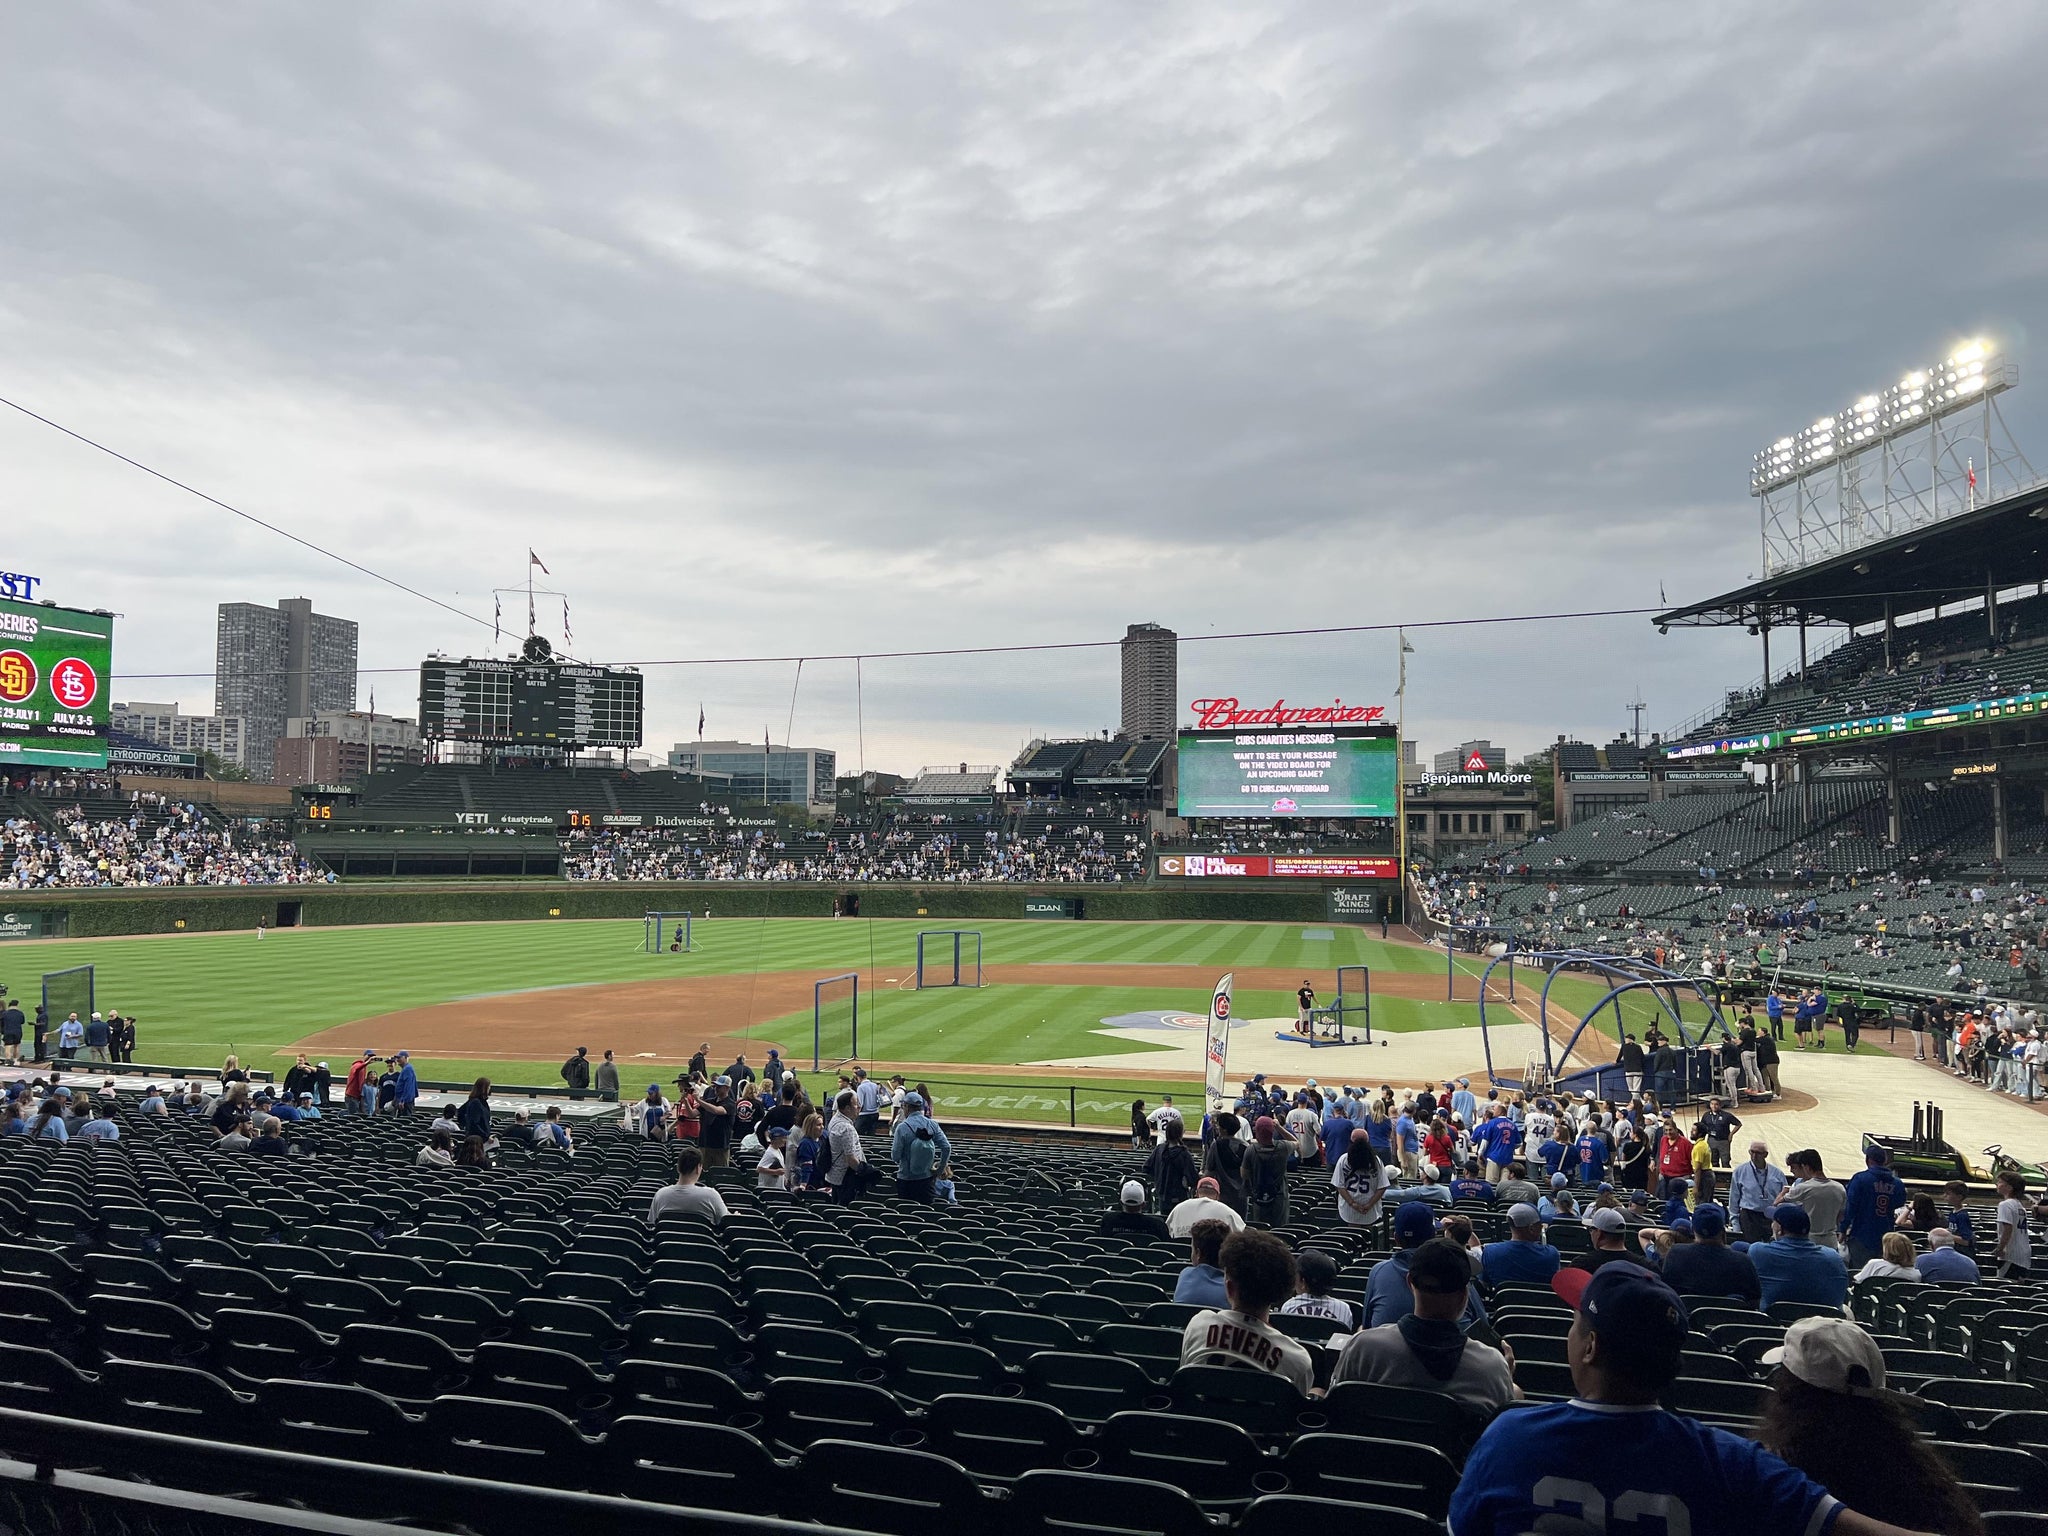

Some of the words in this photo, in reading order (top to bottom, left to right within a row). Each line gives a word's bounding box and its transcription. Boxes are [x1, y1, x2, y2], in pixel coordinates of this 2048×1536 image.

[0, 571, 40, 600] ST
[560, 667, 603, 677] AMERICAN
[1191, 697, 1385, 728] Budweiser
[52, 712, 76, 725] JULY
[77, 715, 93, 726] 3-5
[59, 727, 96, 736] CARDINALS
[1235, 735, 1255, 745] CUBS
[1256, 735, 1295, 745] CHARITIES
[1295, 734, 1335, 744] MESSAGES
[1421, 772, 1484, 786] Benjamin
[1487, 772, 1532, 784] Moore
[326, 785, 351, 794] Mobile
[310, 806, 330, 819] 0:15
[455, 813, 489, 824] YETI
[507, 815, 553, 825] tastytrade
[737, 817, 776, 826] Advocate
[1206, 864, 1246, 875] LANGE
[1333, 894, 1372, 903] DRAFT
[1292, 1122, 1305, 1135] 21
[1532, 1126, 1548, 1138] 44
[1346, 1174, 1371, 1194] 25
[1875, 1195, 1891, 1217] 9
[1205, 1324, 1284, 1372] DEVERS
